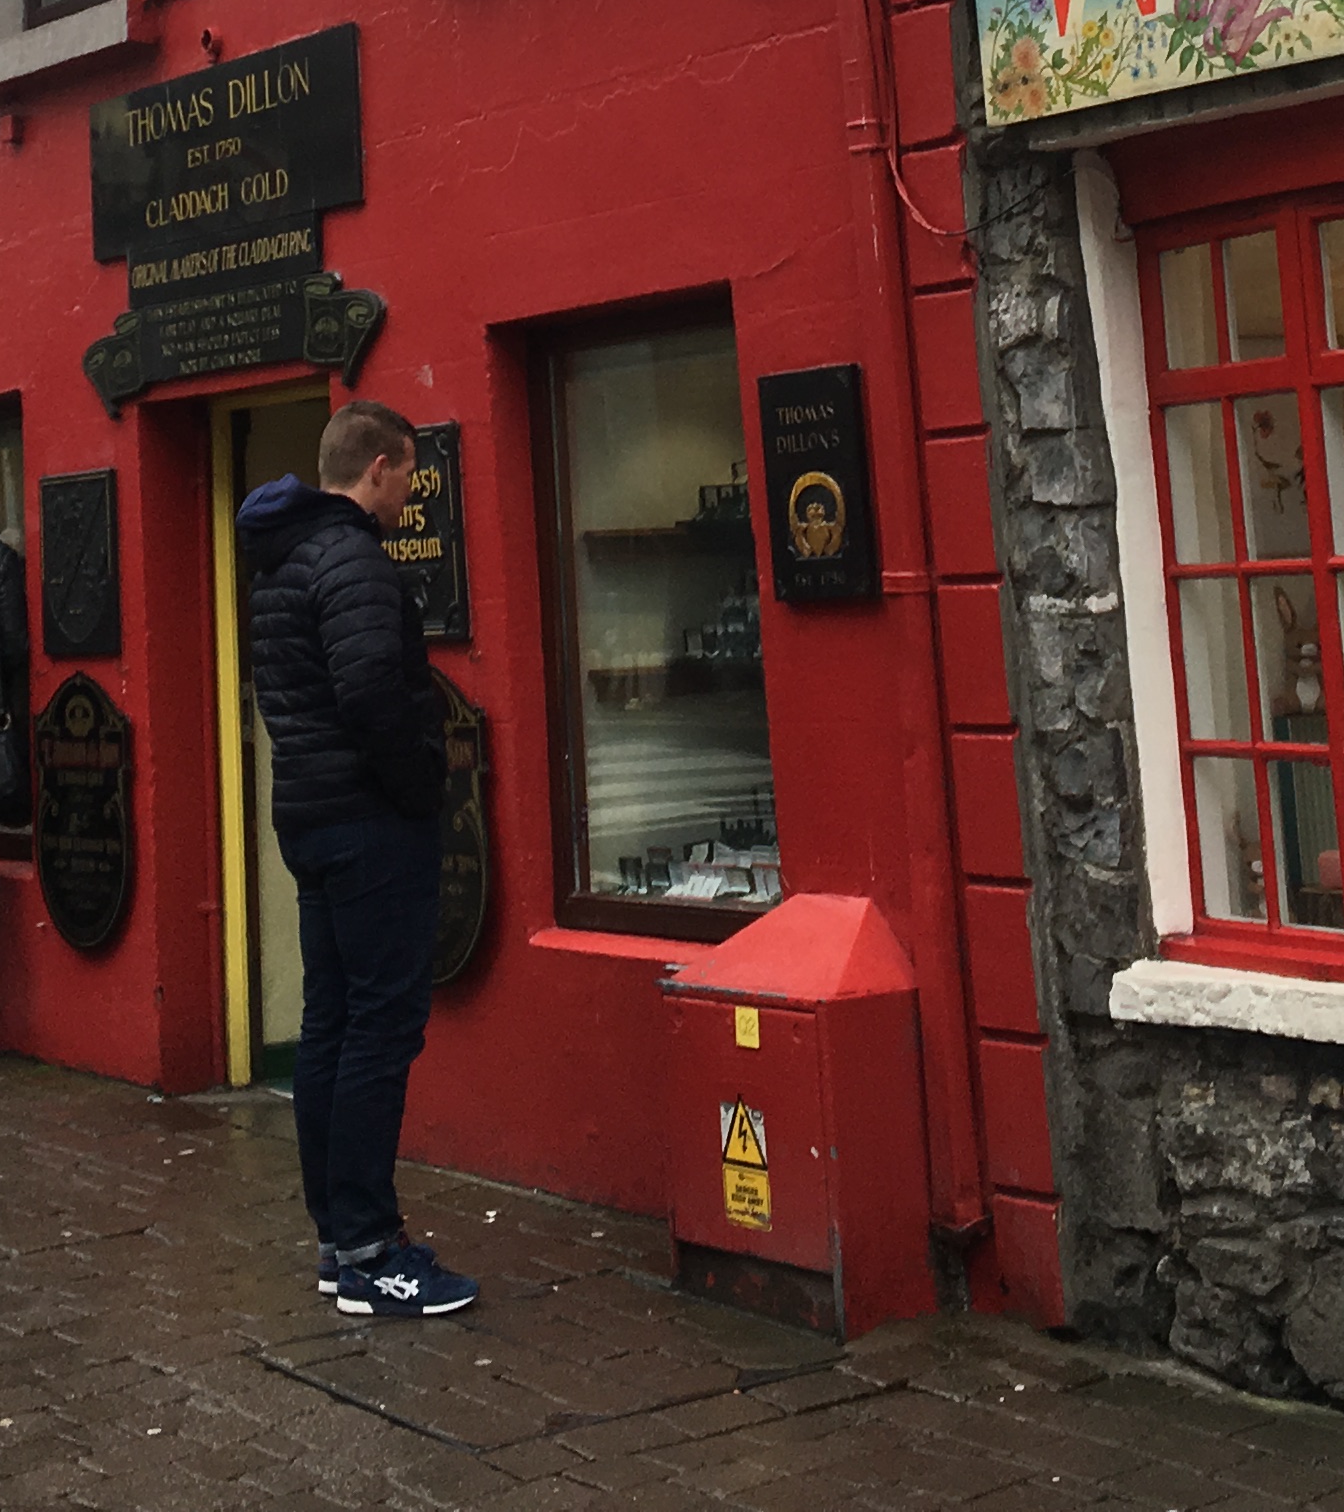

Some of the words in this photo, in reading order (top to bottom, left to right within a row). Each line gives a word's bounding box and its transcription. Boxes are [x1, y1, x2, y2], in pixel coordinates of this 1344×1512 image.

[125, 87, 214, 147] THOMAS
[228, 56, 311, 120] DILLON
[215, 136, 242, 161] 1750
[241, 168, 289, 206] GOLD
[221, 243, 237, 271] THE
[775, 400, 835, 426] THOMAS
